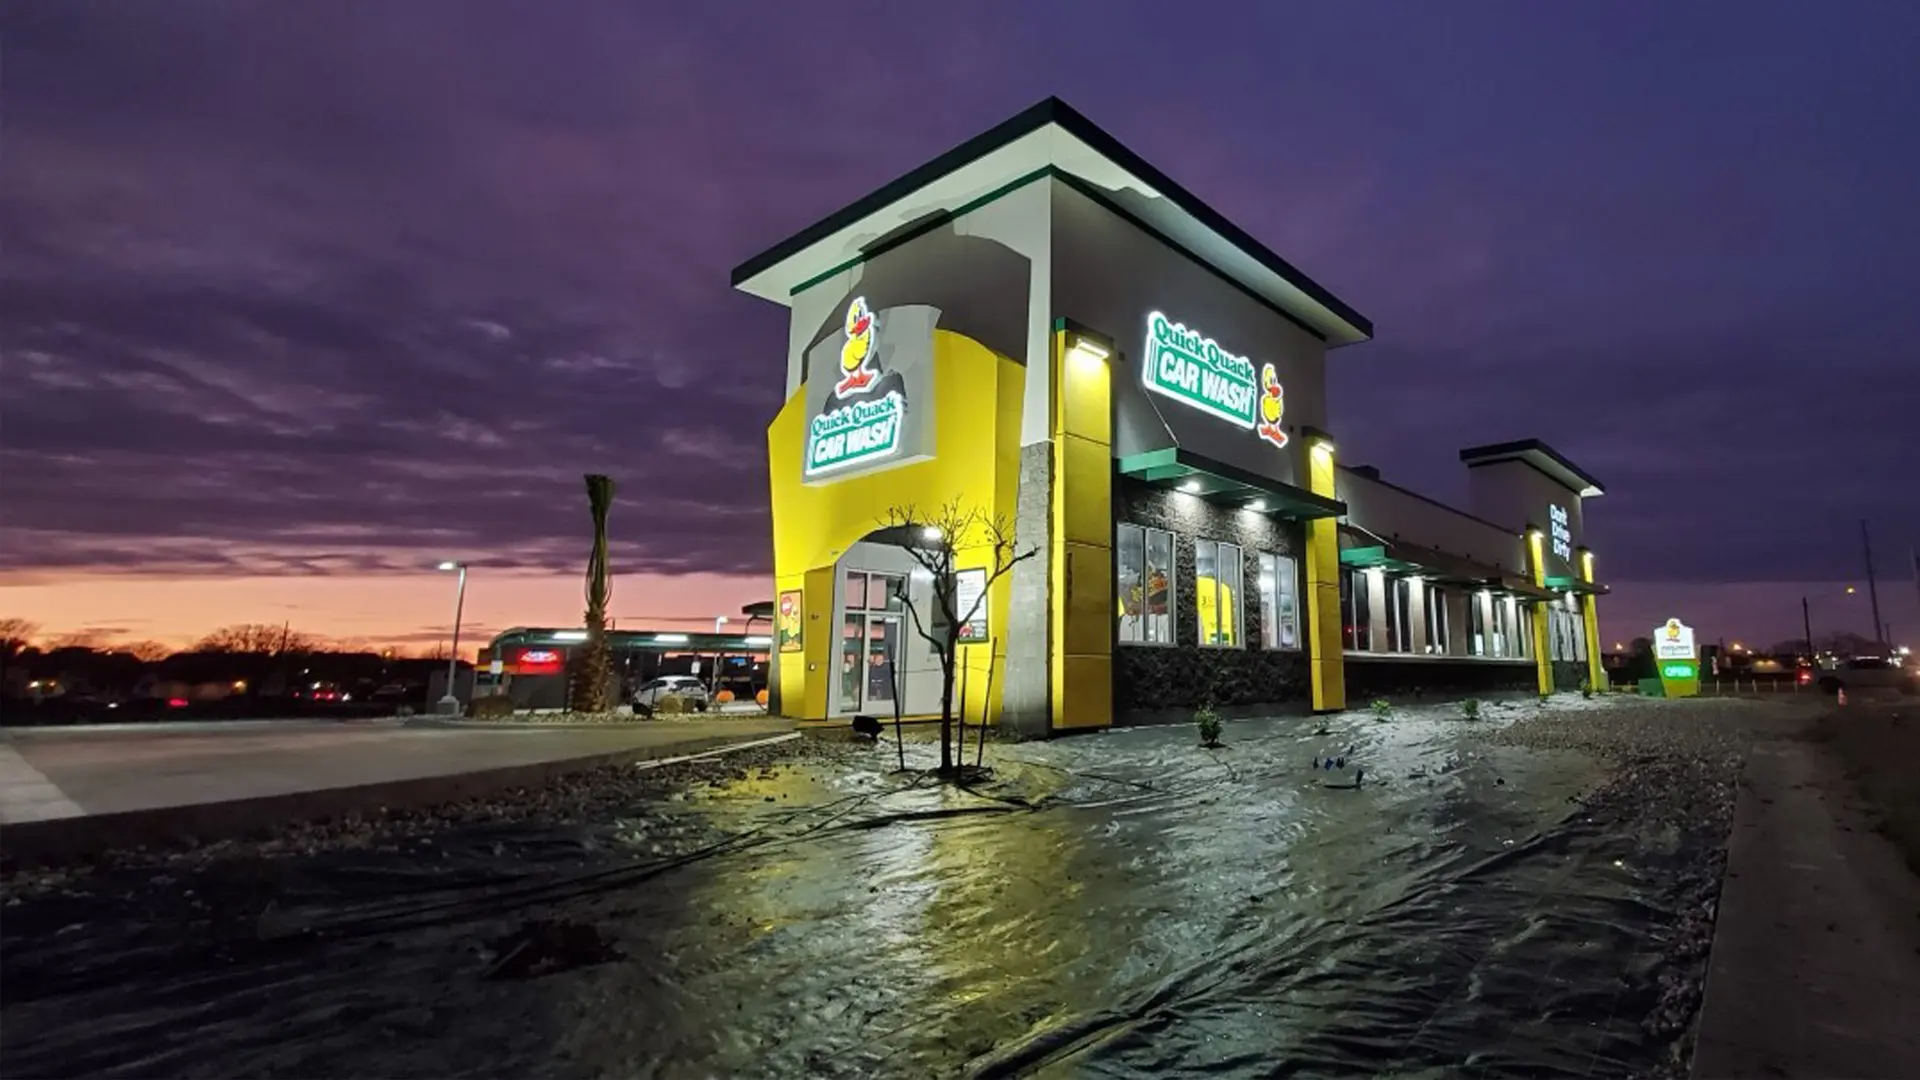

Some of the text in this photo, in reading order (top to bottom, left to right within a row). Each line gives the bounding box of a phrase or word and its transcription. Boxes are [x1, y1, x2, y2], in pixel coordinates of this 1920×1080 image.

[1154, 317, 1255, 380] Quick Quack
[1159, 351, 1252, 416] CAR WASH
[812, 398, 897, 436] Quick Quack
[814, 418, 892, 463] CAR WASH
